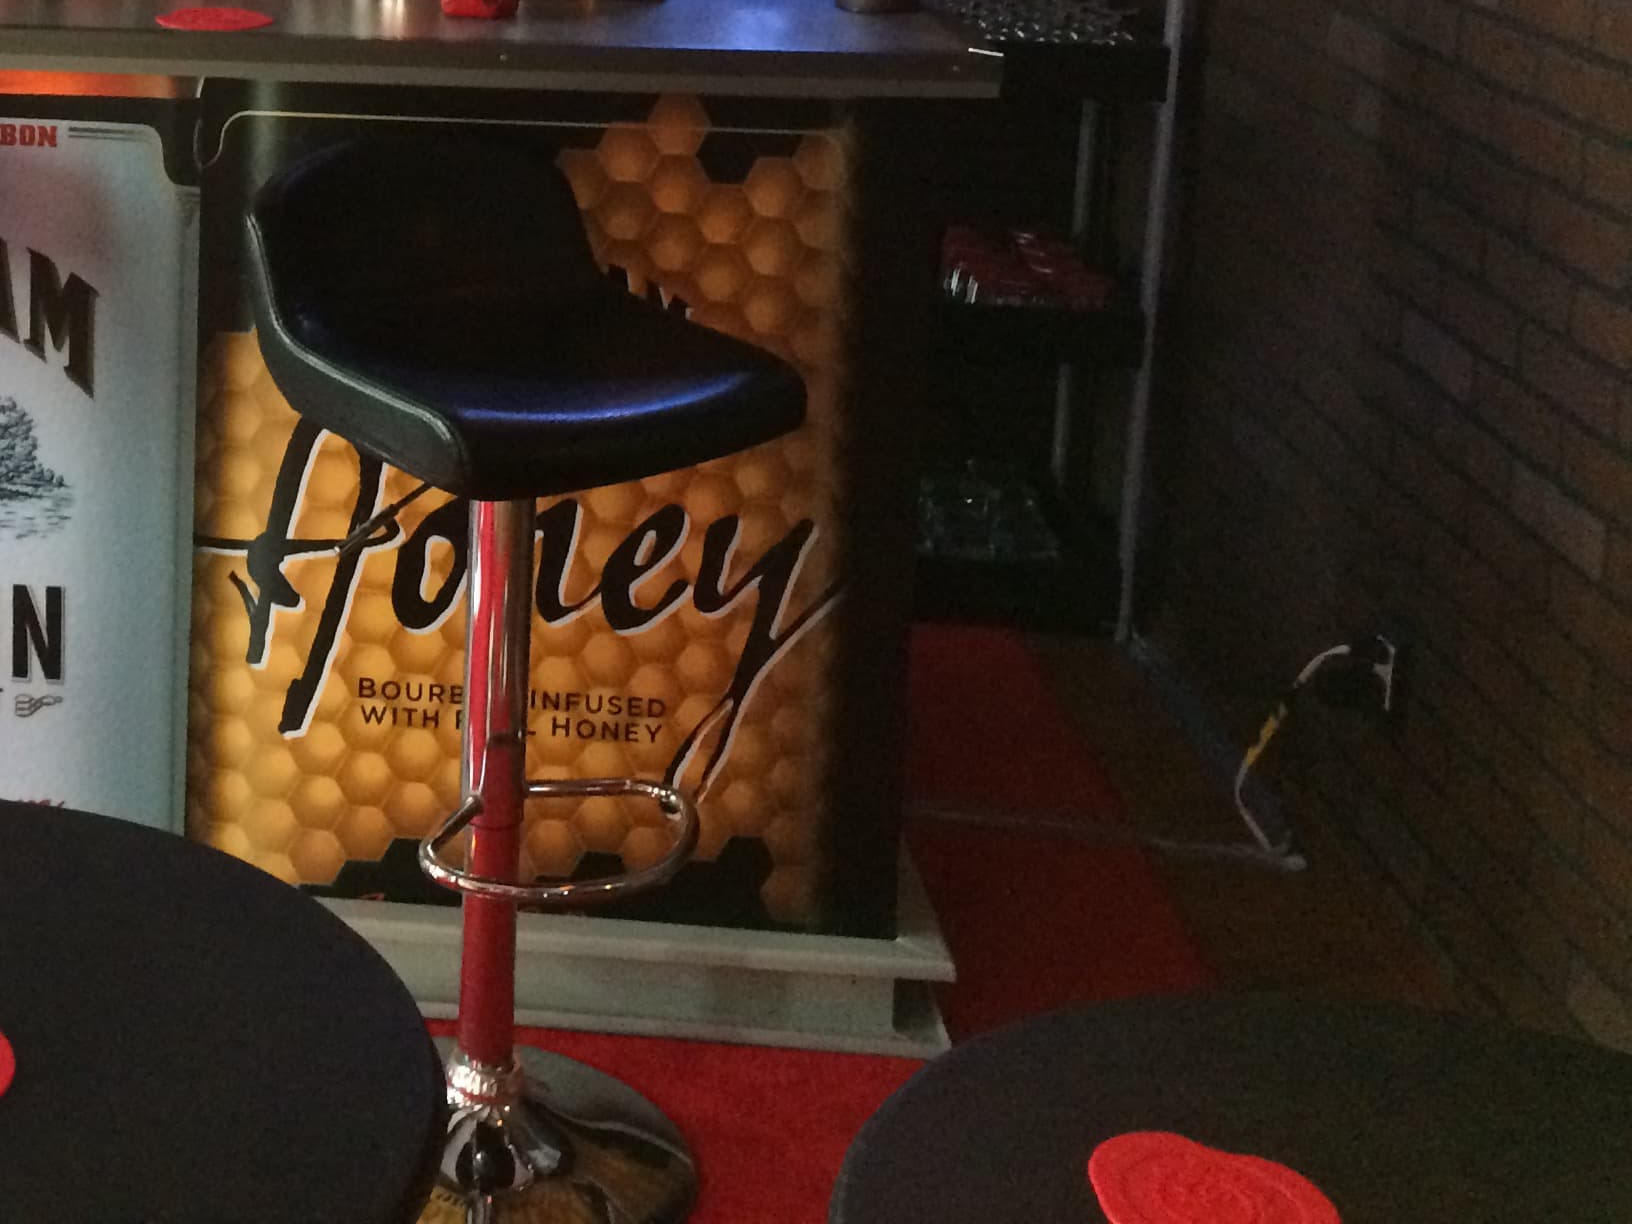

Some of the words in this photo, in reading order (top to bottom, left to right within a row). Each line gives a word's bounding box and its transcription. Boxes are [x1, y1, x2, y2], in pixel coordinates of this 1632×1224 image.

[530, 688, 667, 719] INFUSED
[361, 704, 440, 728] WITH
[551, 716, 664, 744] HONEY
